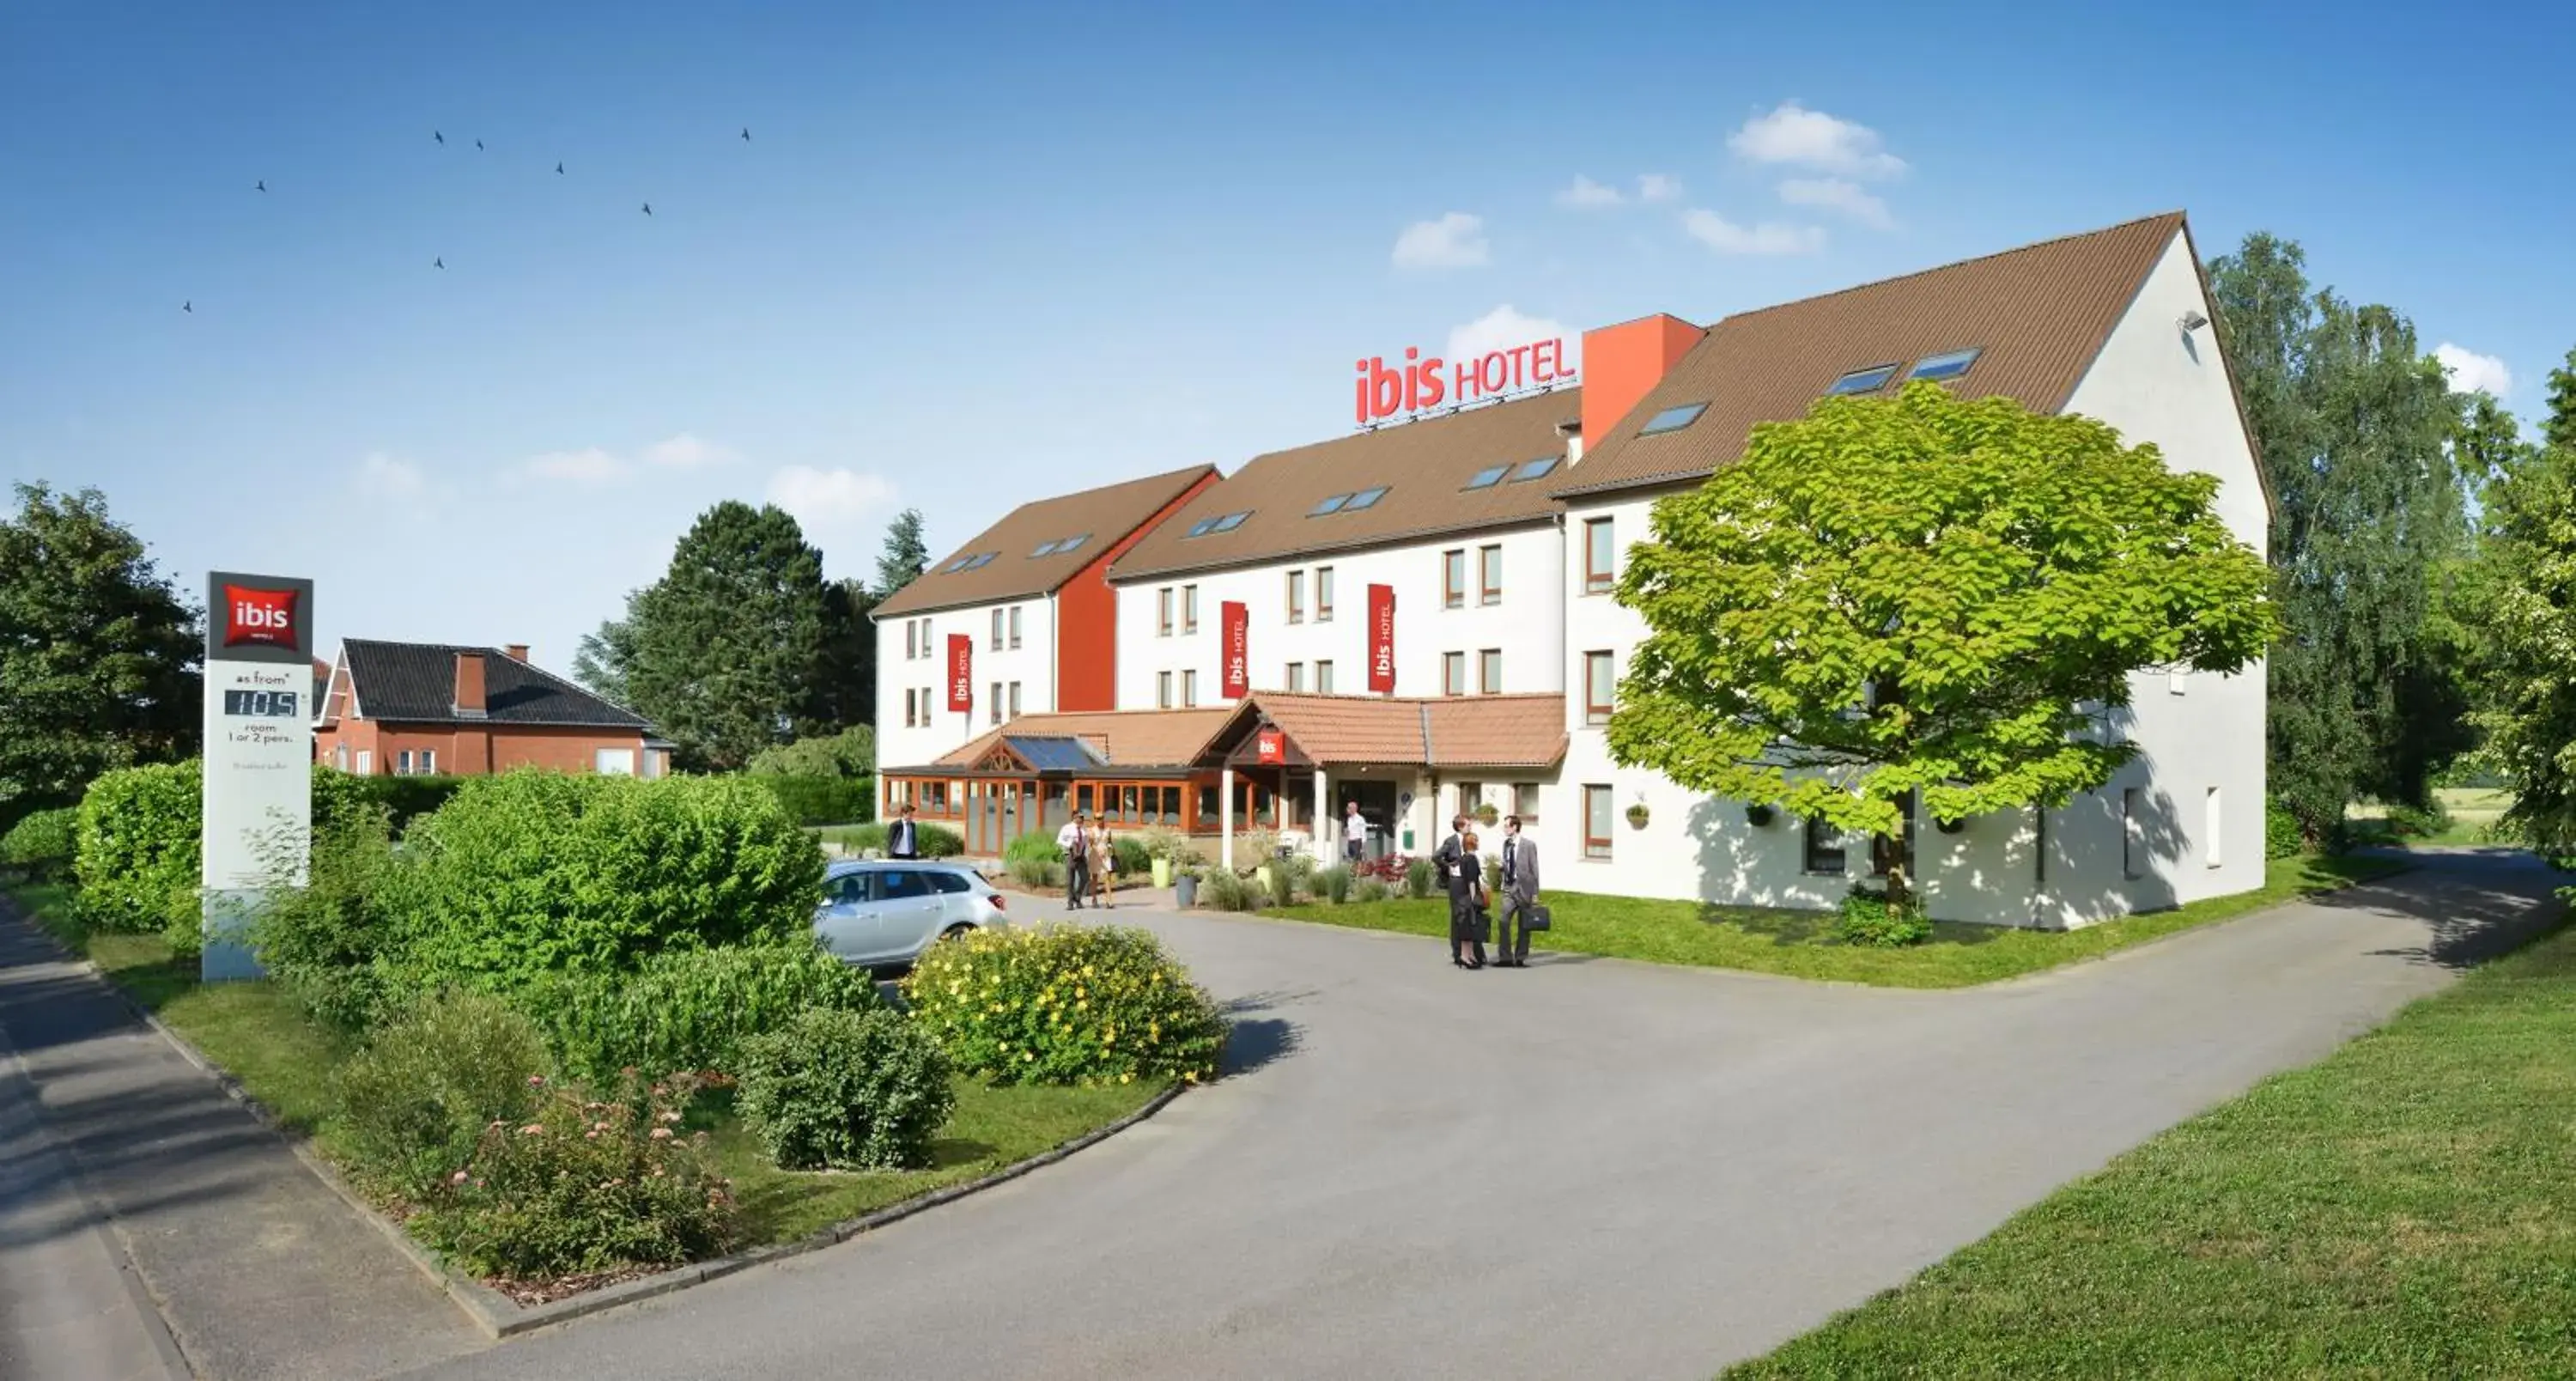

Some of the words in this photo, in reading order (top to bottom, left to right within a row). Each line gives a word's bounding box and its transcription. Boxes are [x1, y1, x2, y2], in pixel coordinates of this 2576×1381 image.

[1356, 346, 1444, 423] ibis
[1455, 338, 1576, 400] HOTEL
[236, 600, 288, 628] ibis
[1381, 603, 1391, 641] HOTEL
[1229, 656, 1243, 684] ibis
[1376, 645, 1391, 677] ibis
[236, 675, 251, 684] as
[954, 678, 968, 702] ibis
[245, 724, 276, 733] room
[253, 733, 261, 743] 2
